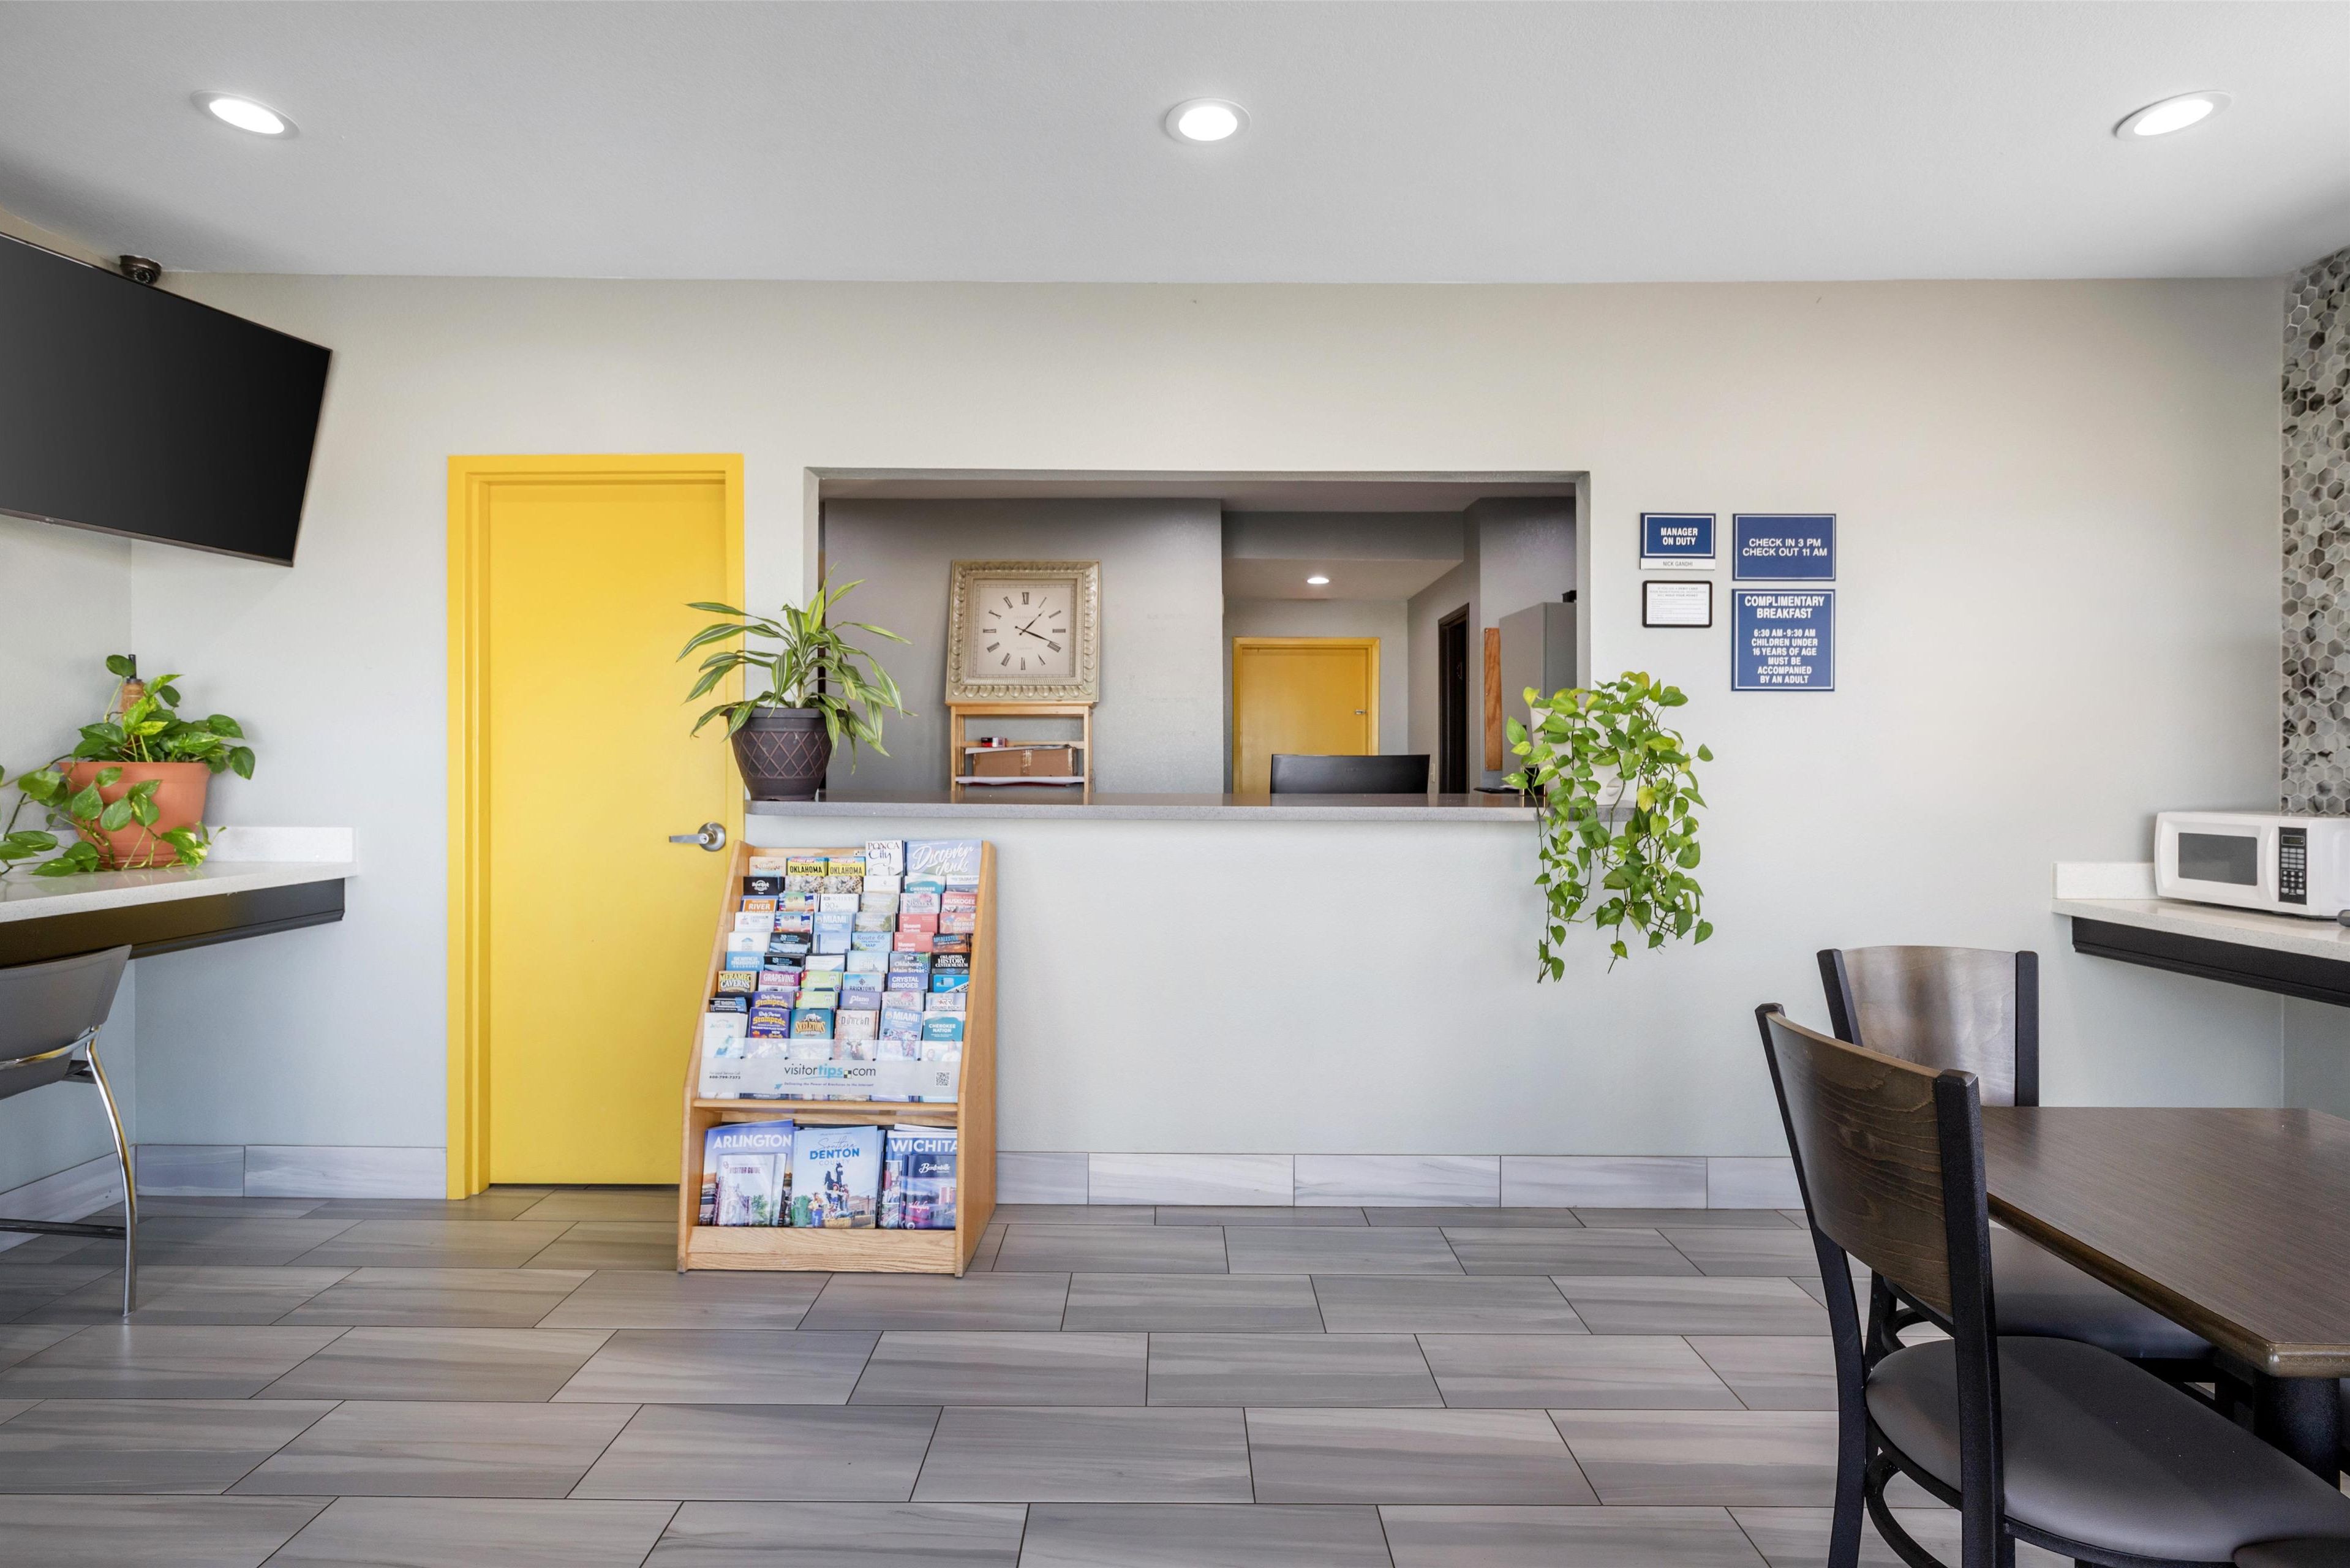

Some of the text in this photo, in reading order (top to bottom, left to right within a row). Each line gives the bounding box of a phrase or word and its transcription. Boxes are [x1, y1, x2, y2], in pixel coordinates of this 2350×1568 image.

[1660, 527, 1698, 536] MANAGER
[1662, 537, 1674, 545] ON
[1749, 538, 1821, 547] CHECK IN 3 PM
[1742, 548, 1776, 556] CHECK
[1779, 548, 1799, 556] OUT
[1745, 595, 1825, 606] COMPLIMENTARY
[1757, 608, 1812, 619] BREAKFAST
[868, 842, 900, 850] PONCA
[868, 849, 892, 864] City
[912, 842, 974, 870] Discover
[823, 915, 846, 924] MIAMI
[763, 973, 794, 983] GRAPEVINE
[755, 999, 789, 1008] Stampede
[753, 1016, 786, 1027] Stampede
[893, 1011, 918, 1022] MIAMI
[795, 1021, 826, 1034] SKELETONS
[714, 1134, 792, 1148] ARLINGTON
[810, 1148, 860, 1159] DENTON
